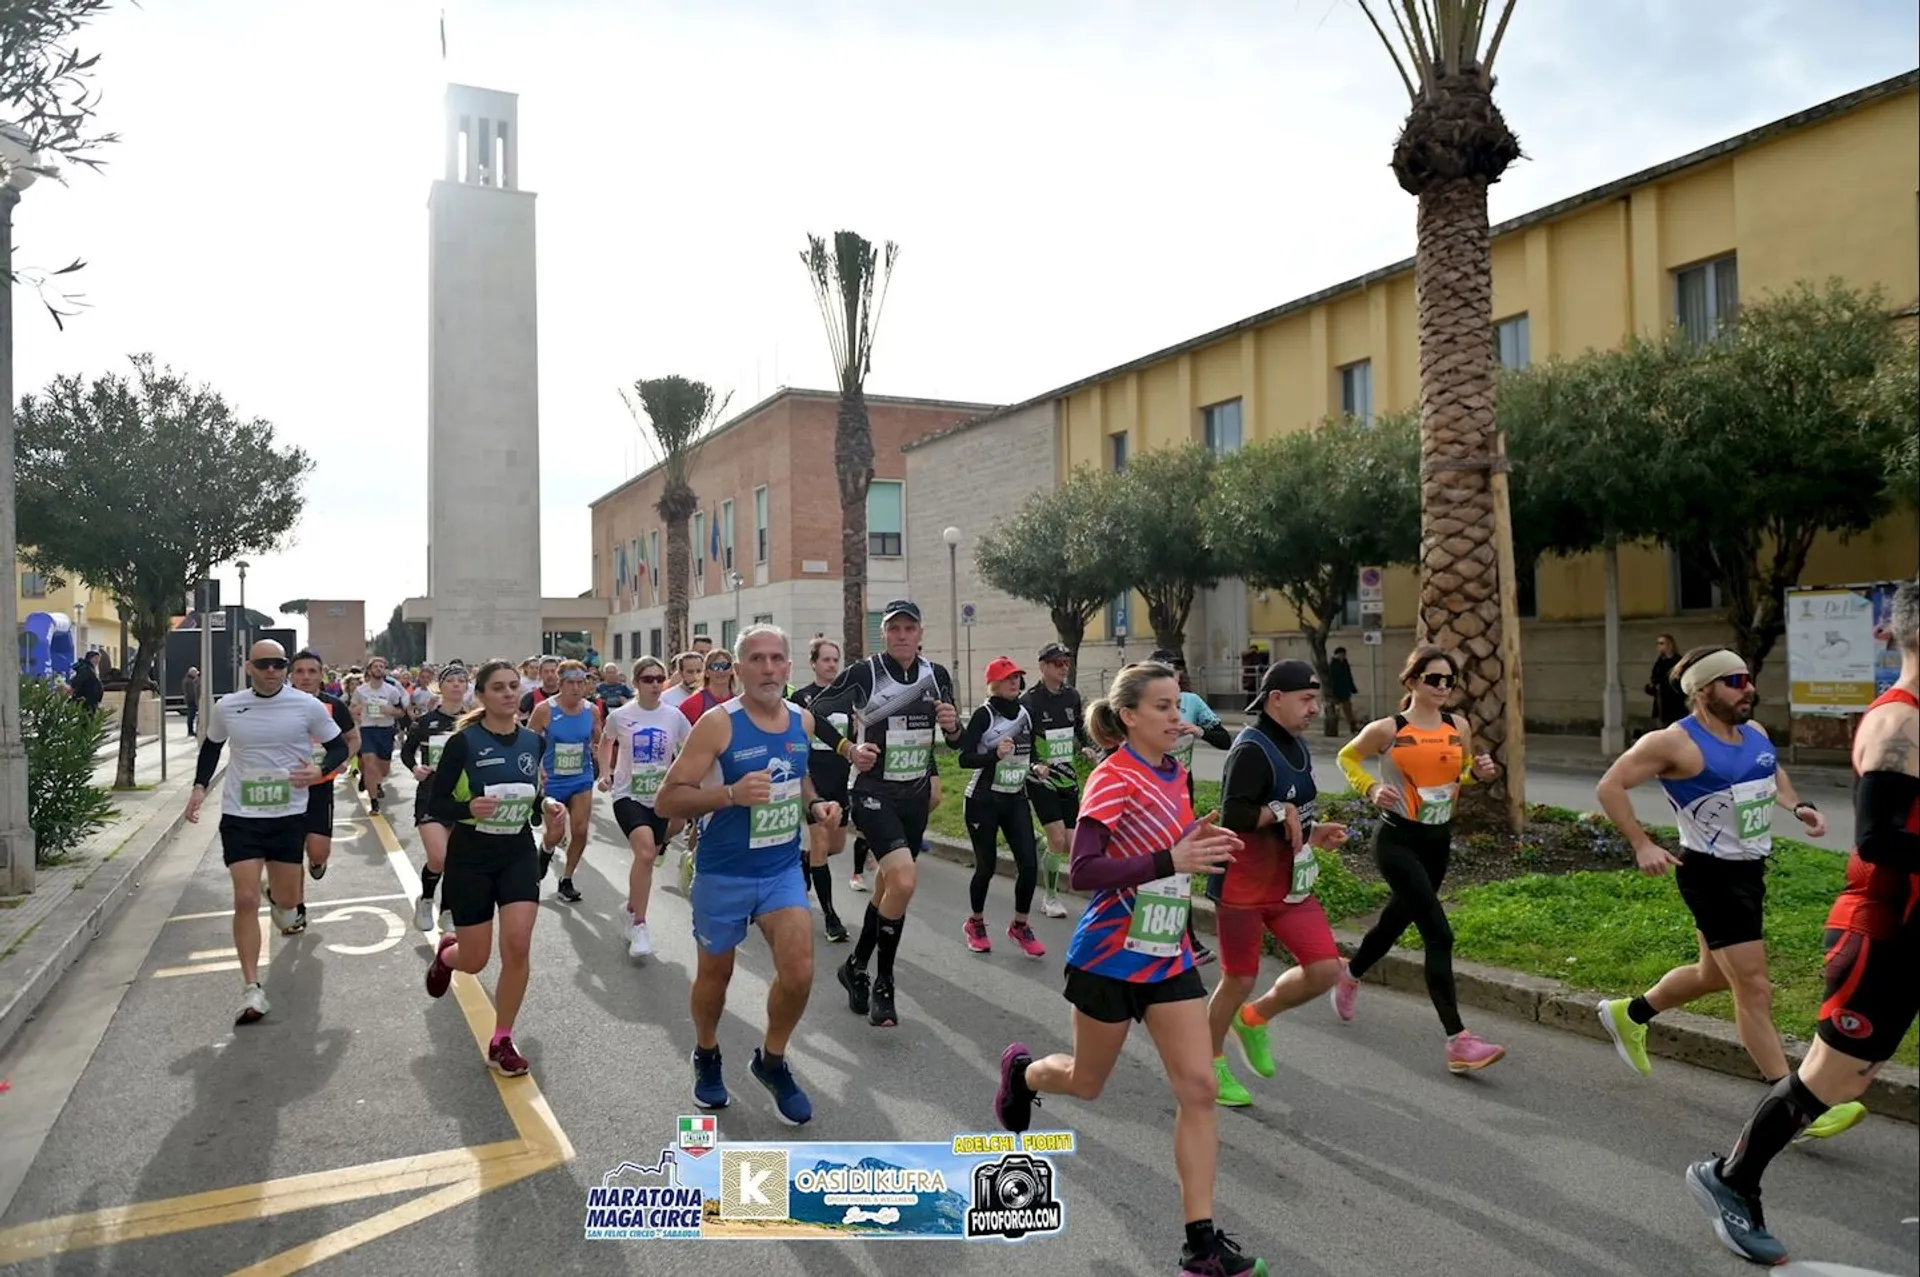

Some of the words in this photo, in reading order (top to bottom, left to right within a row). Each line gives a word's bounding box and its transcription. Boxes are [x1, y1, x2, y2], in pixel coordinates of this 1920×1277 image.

[890, 750, 927, 769] 2342
[635, 778, 661, 792] 216
[1000, 769, 1025, 783] 1897
[247, 786, 283, 802] 1814
[756, 803, 799, 832] 2233
[1742, 800, 1774, 833] 230
[1142, 903, 1186, 935] 1849
